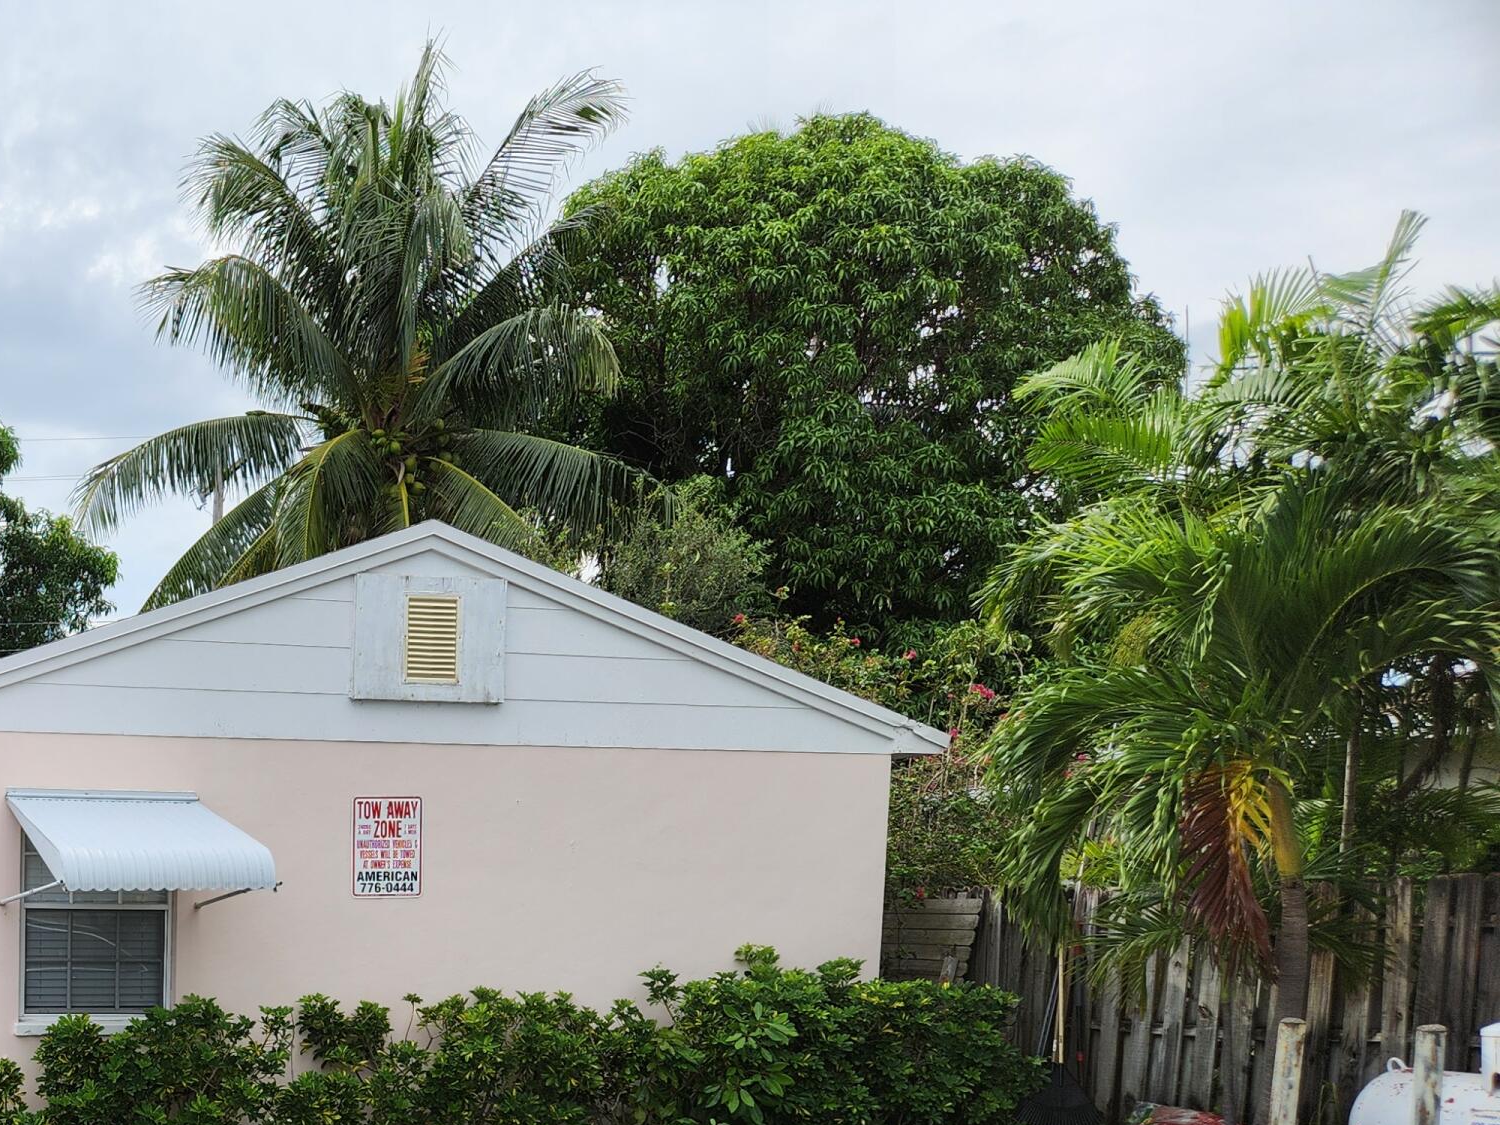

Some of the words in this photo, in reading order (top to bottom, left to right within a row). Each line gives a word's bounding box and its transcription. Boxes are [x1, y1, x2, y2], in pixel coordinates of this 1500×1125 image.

[357, 801, 382, 819] TOW
[387, 801, 418, 819] AWAY
[374, 820, 402, 838] ZONE
[357, 840, 390, 848] UNAUTHORIZED
[393, 840, 412, 848] VEHICLES
[360, 850, 378, 858] VESSELS
[381, 850, 391, 858] WILL
[393, 850, 398, 858] BE
[401, 850, 415, 858] TOWED
[363, 860, 368, 869] AT
[393, 860, 411, 868] EXPENSE
[357, 871, 418, 881] AMERICAN
[360, 882, 414, 893] 776-0444
